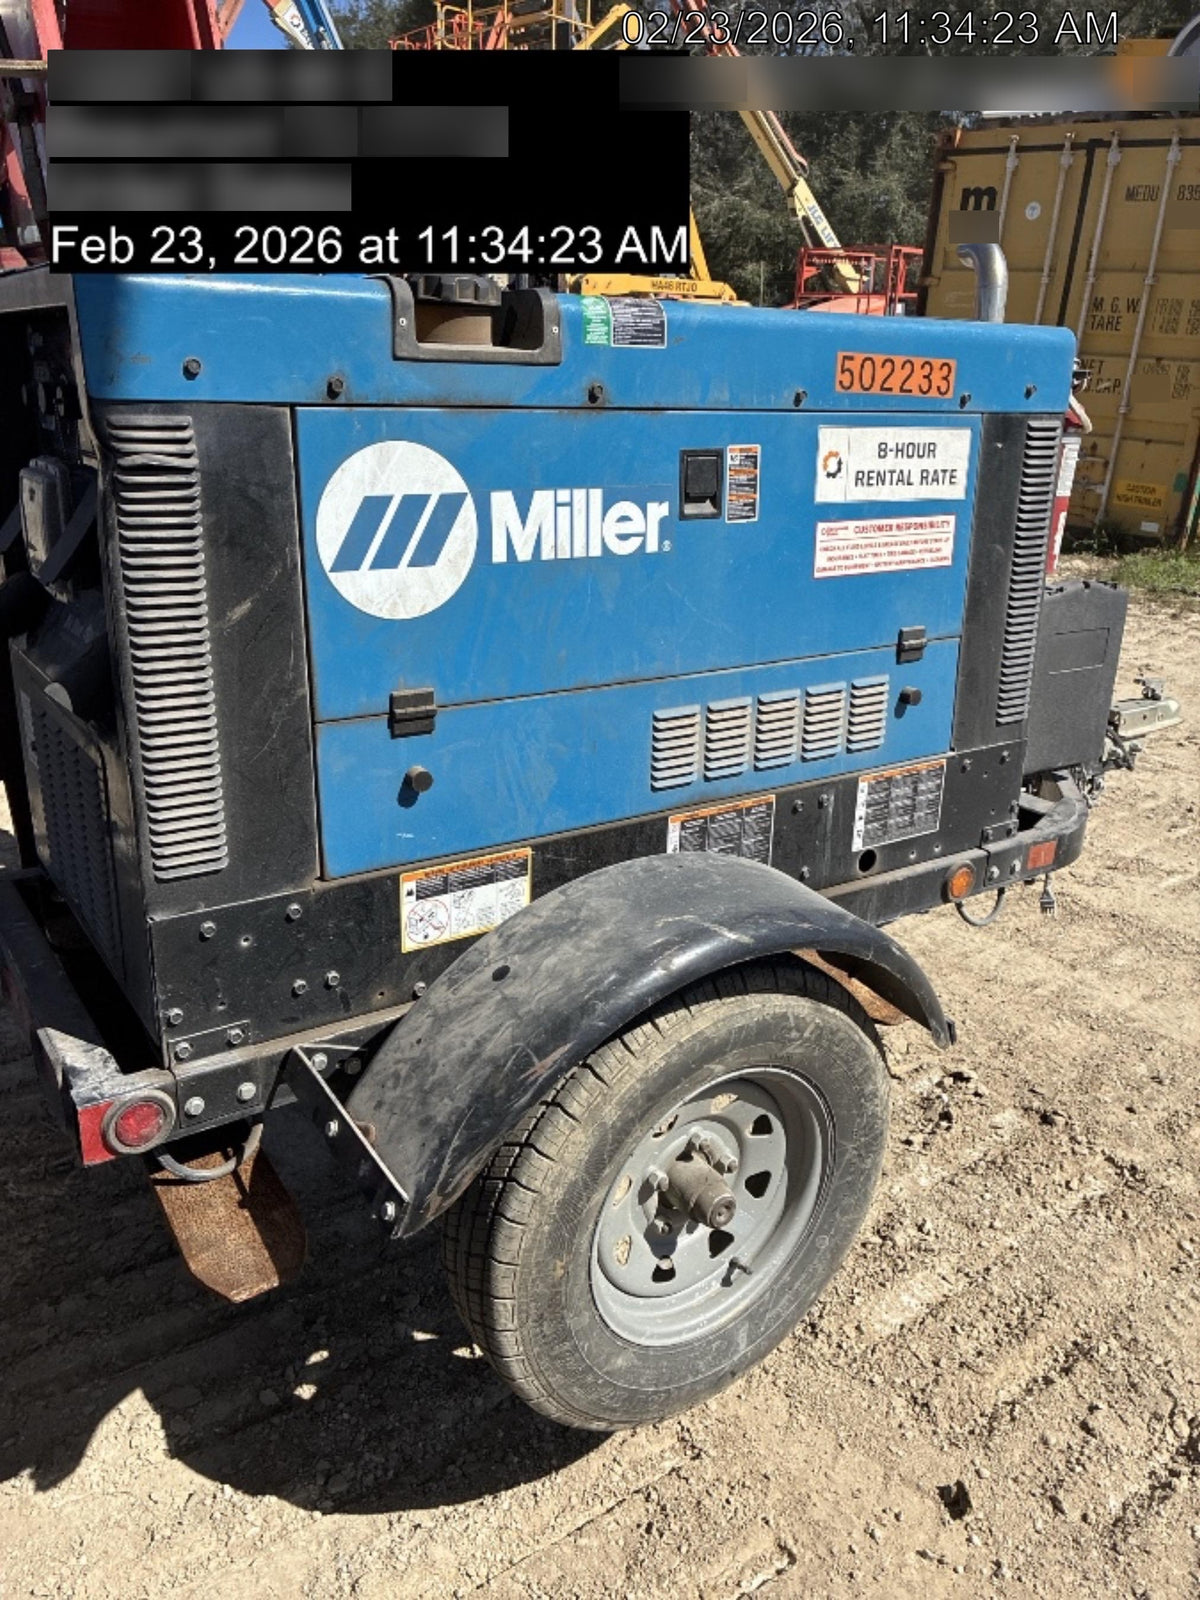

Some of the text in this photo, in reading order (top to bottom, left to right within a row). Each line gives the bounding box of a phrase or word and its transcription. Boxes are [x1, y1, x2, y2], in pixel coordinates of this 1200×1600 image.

[1125, 184, 1160, 201] MEDU
[1090, 314, 1122, 331] TARE
[838, 355, 952, 396] 502233
[877, 442, 937, 459] 8-HOUR
[855, 468, 957, 487] RENTAL RATE
[853, 524, 893, 535] CUSTOMER
[896, 520, 950, 532] RESPONSIBILITY
